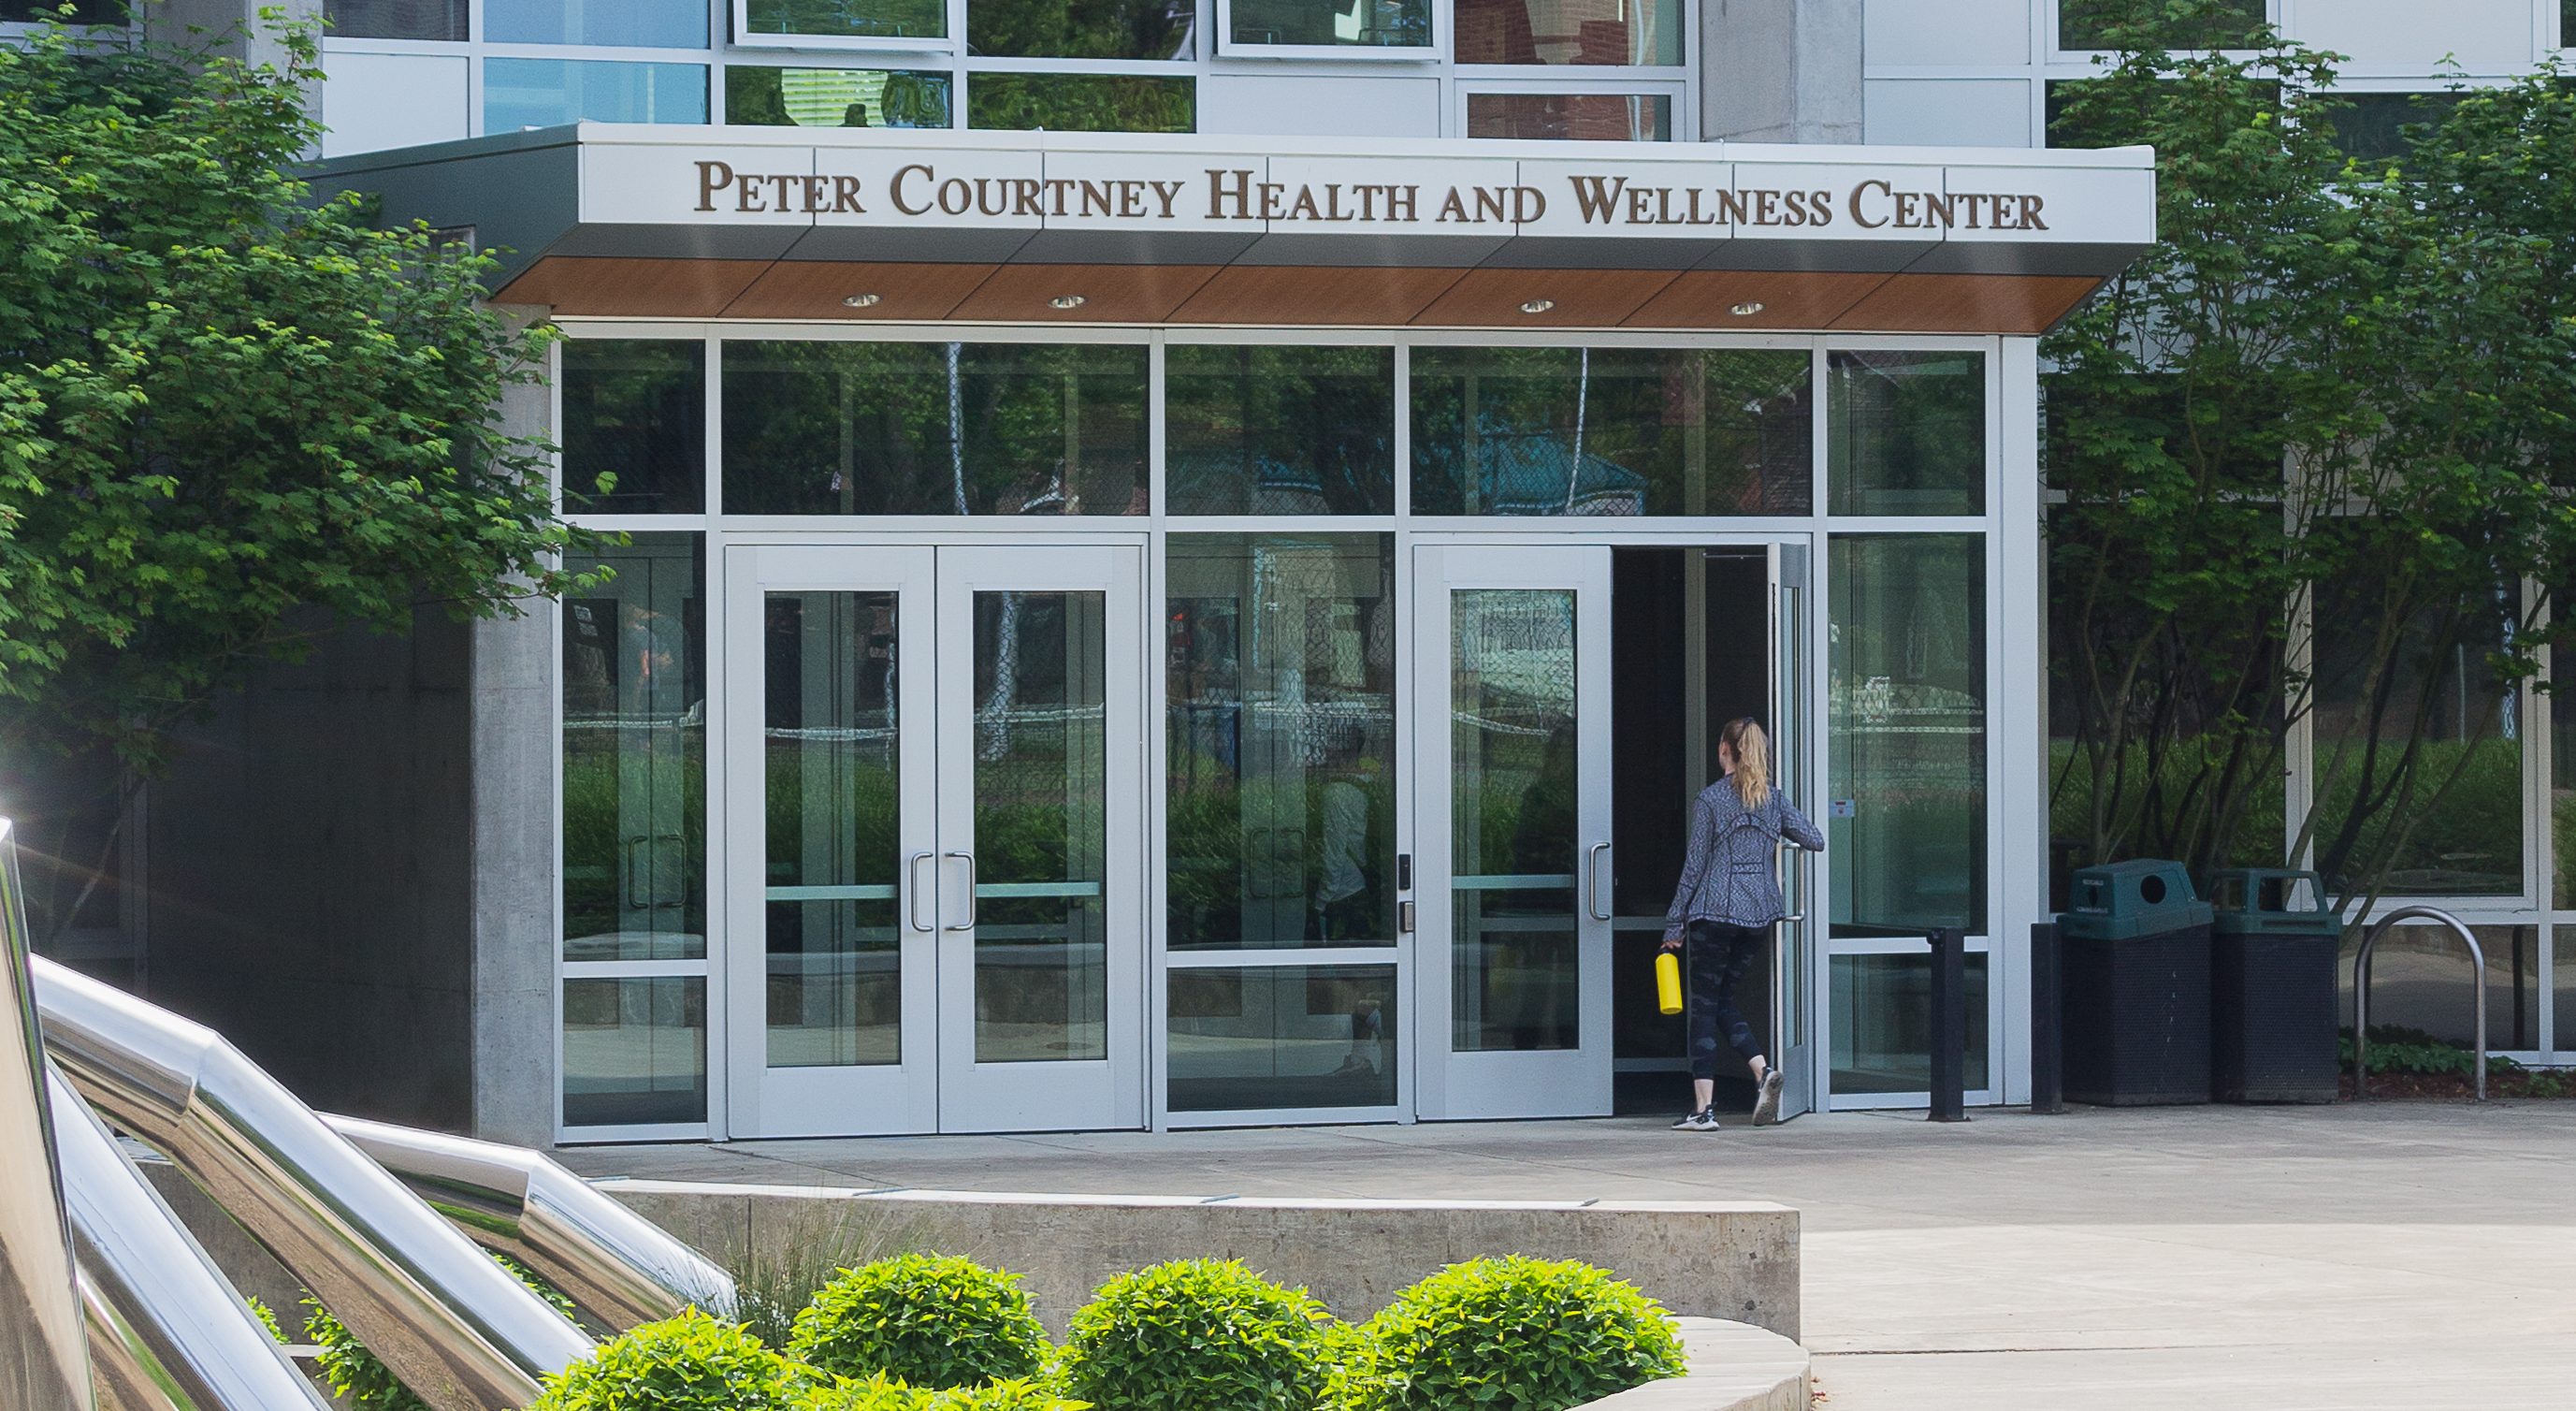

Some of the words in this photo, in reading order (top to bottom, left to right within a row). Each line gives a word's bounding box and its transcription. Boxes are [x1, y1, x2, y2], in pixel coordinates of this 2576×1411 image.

[693, 160, 867, 214] PETER
[889, 164, 1186, 219] COURTNEY
[1204, 168, 1420, 223] HEALTH
[1435, 184, 1548, 225] AND
[1568, 174, 1833, 227] WELLNESS
[1847, 179, 2050, 231] CENTER
